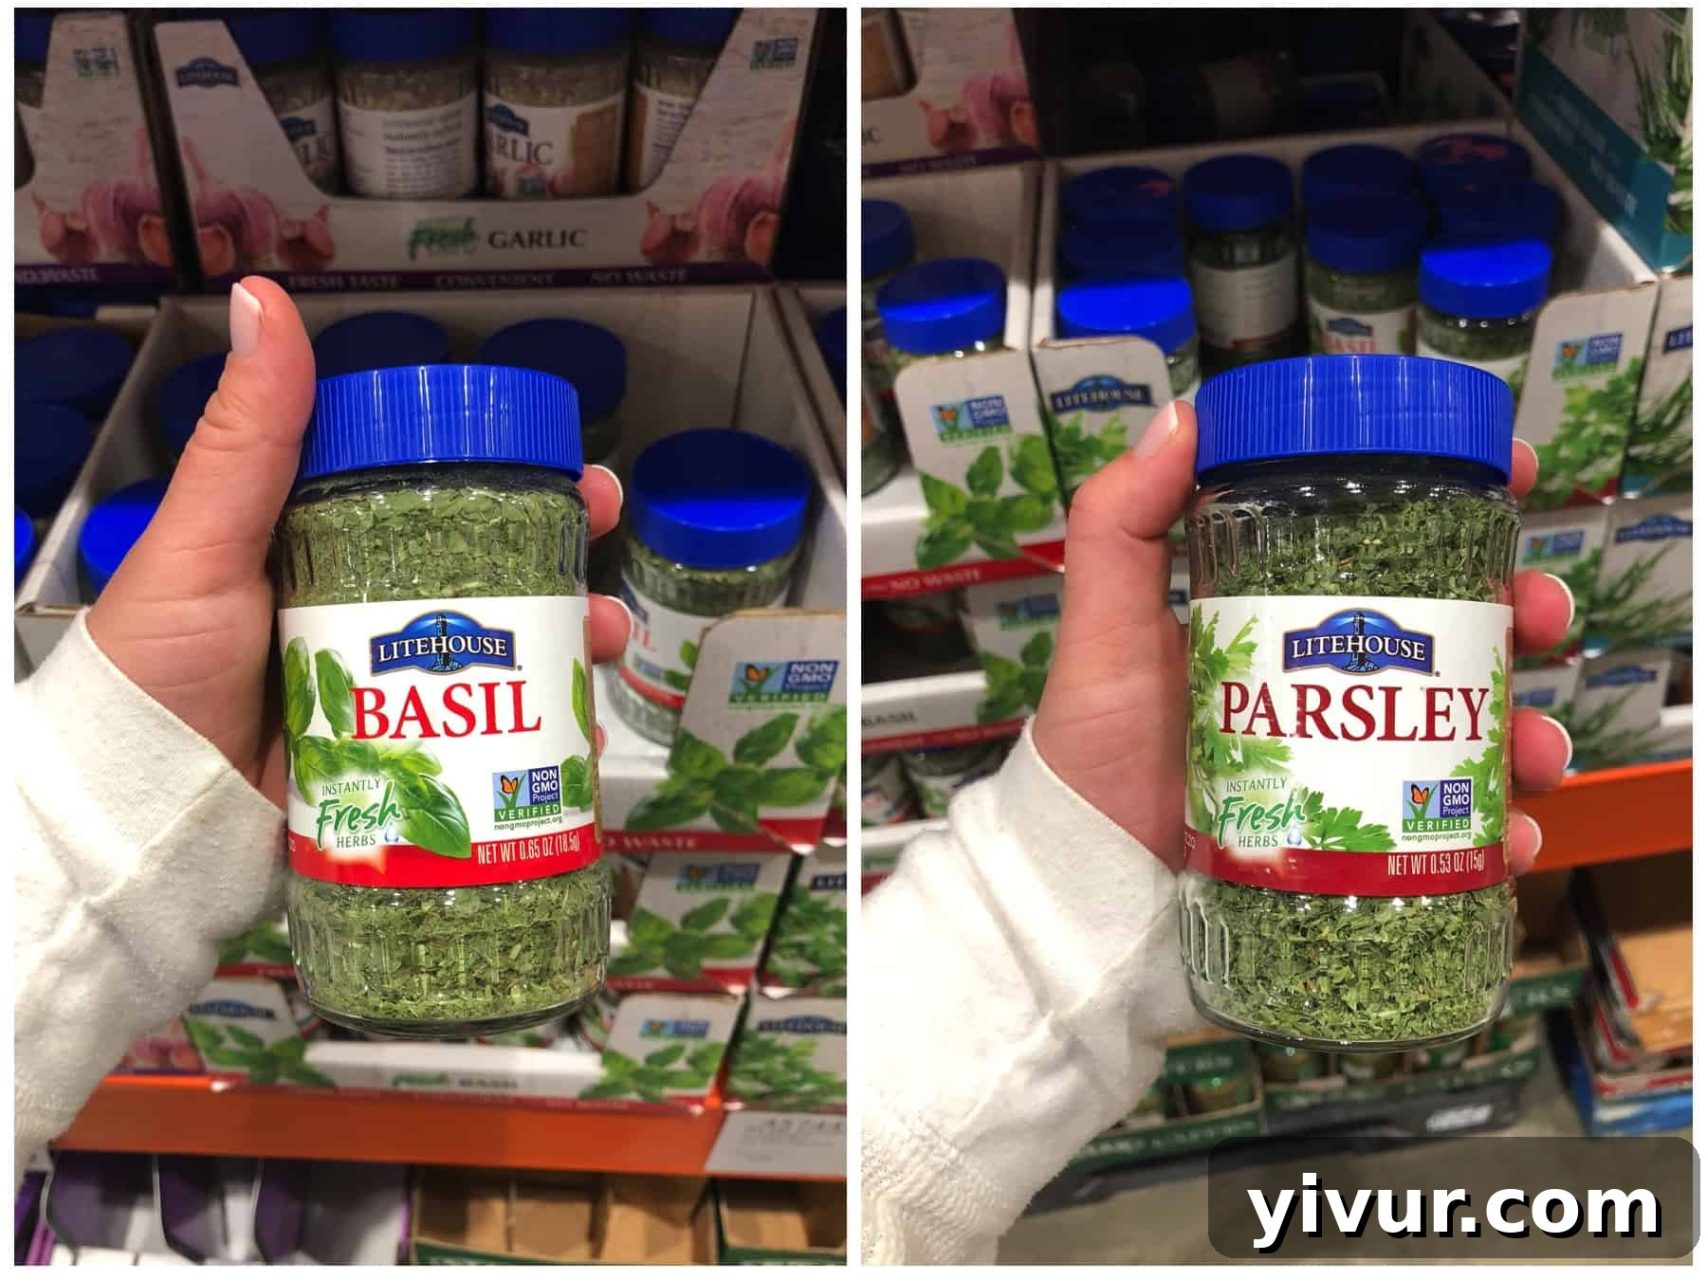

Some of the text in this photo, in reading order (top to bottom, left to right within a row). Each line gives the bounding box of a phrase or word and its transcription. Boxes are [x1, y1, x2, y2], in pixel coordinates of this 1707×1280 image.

[488, 229, 586, 250] GARLIC
[379, 635, 508, 663] LITEHOUSE
[1292, 635, 1426, 661] LITEHOUSE
[790, 663, 834, 673] NON
[787, 673, 831, 683] GMO
[350, 680, 542, 740] BASIL
[1219, 681, 1490, 741] PARSLEY
[532, 769, 557, 782] NON
[322, 778, 380, 796] INSTANTLY
[532, 781, 558, 793] GMO
[1226, 777, 1287, 793] INSTANTLY
[1443, 782, 1469, 794] NON
[532, 793, 559, 803] Project
[1443, 794, 1470, 806] GMO
[316, 780, 400, 849] Fresh
[498, 805, 560, 820] VERIFIED
[1218, 786, 1305, 848] Fresh
[1443, 806, 1469, 817] Project
[494, 816, 563, 830] nongmoproject.org
[1407, 819, 1470, 831] VERIFIED
[336, 834, 376, 848] HERBS
[1238, 835, 1279, 848] HERBS
[1402, 831, 1471, 842] nongmoproject.org
[478, 831, 580, 865] NET WT 0.65 OZ (18.5g)
[1388, 849, 1485, 876] NET WT 0.53 OZ (15g)
